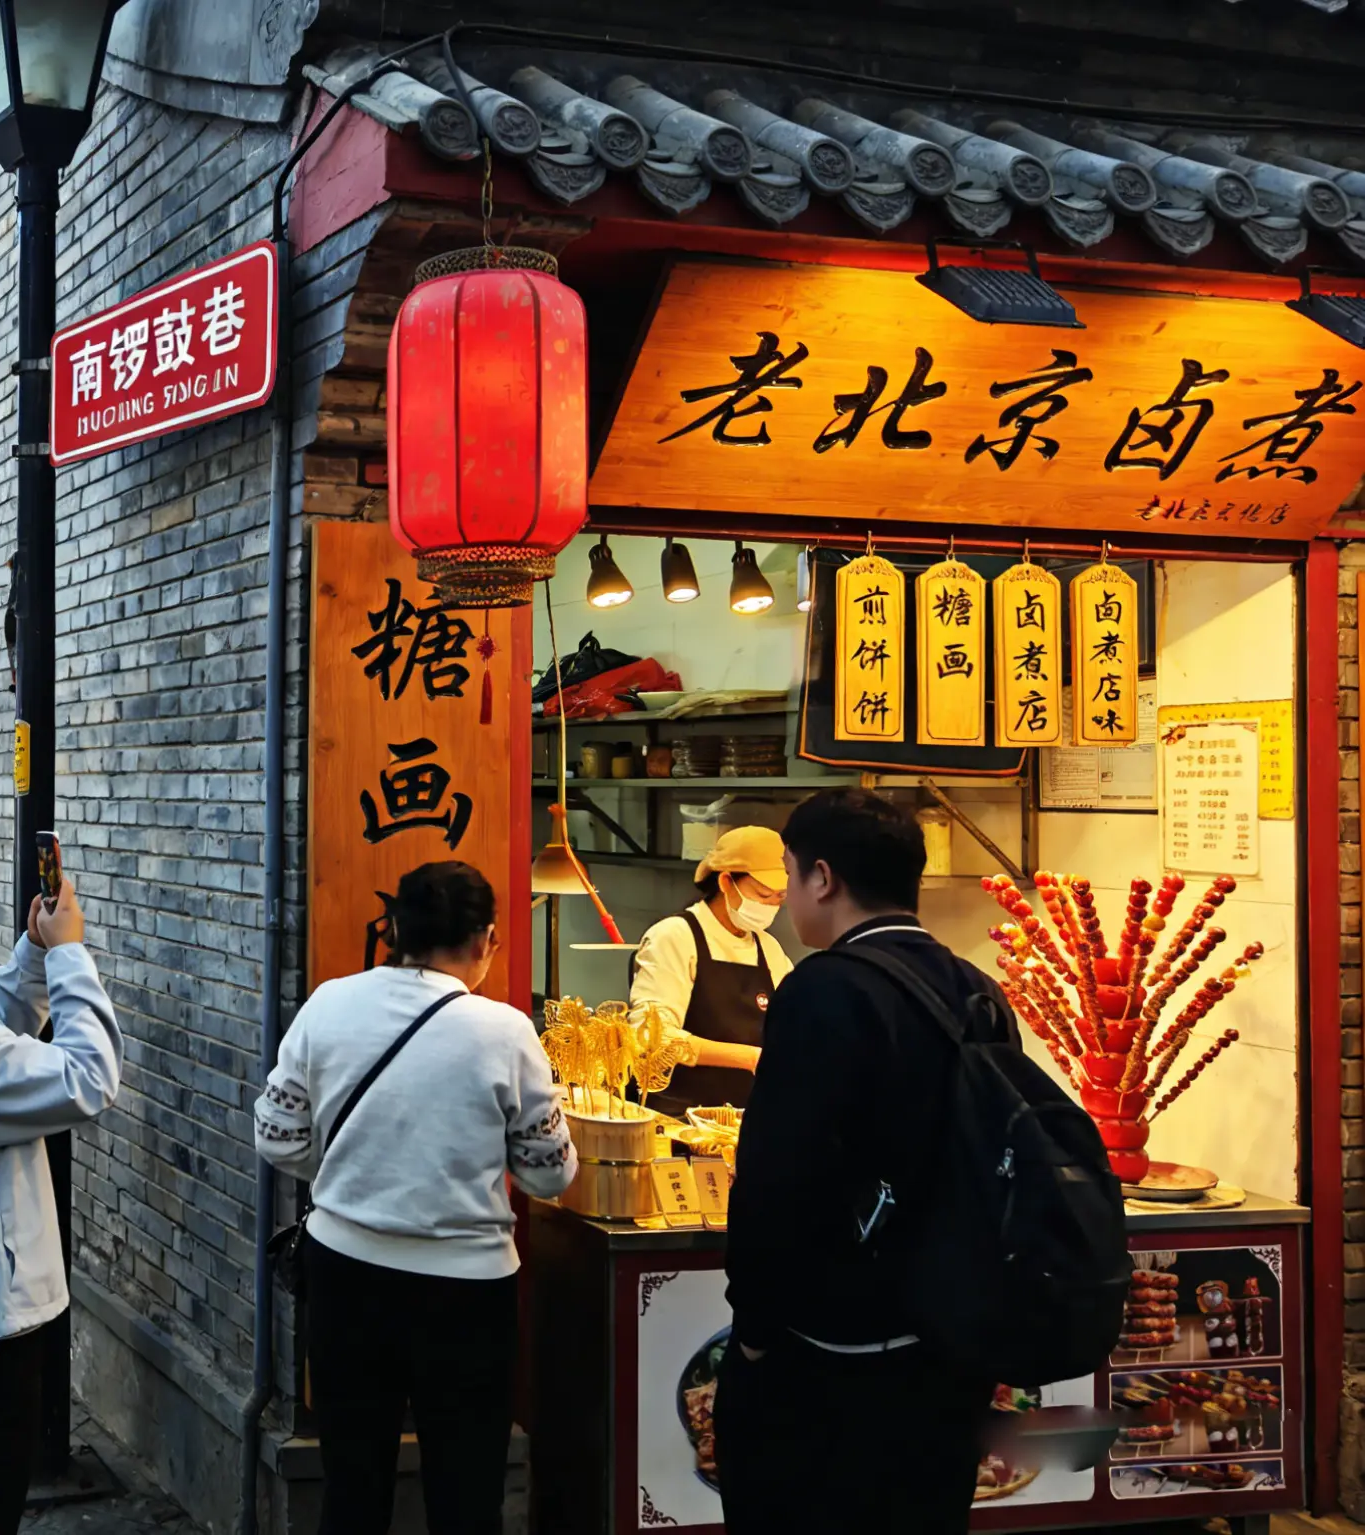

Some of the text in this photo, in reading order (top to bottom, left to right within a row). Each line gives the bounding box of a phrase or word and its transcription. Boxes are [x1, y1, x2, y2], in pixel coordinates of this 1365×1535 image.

[69, 281, 245, 406] 南锣鼓巷
[657, 331, 1363, 485] 老北京卤煮
[850, 586, 891, 732] 煎饼饼
[933, 586, 973, 679] 糖画
[1012, 590, 1049, 733] 卤煮店
[351, 578, 474, 970] 糖画
